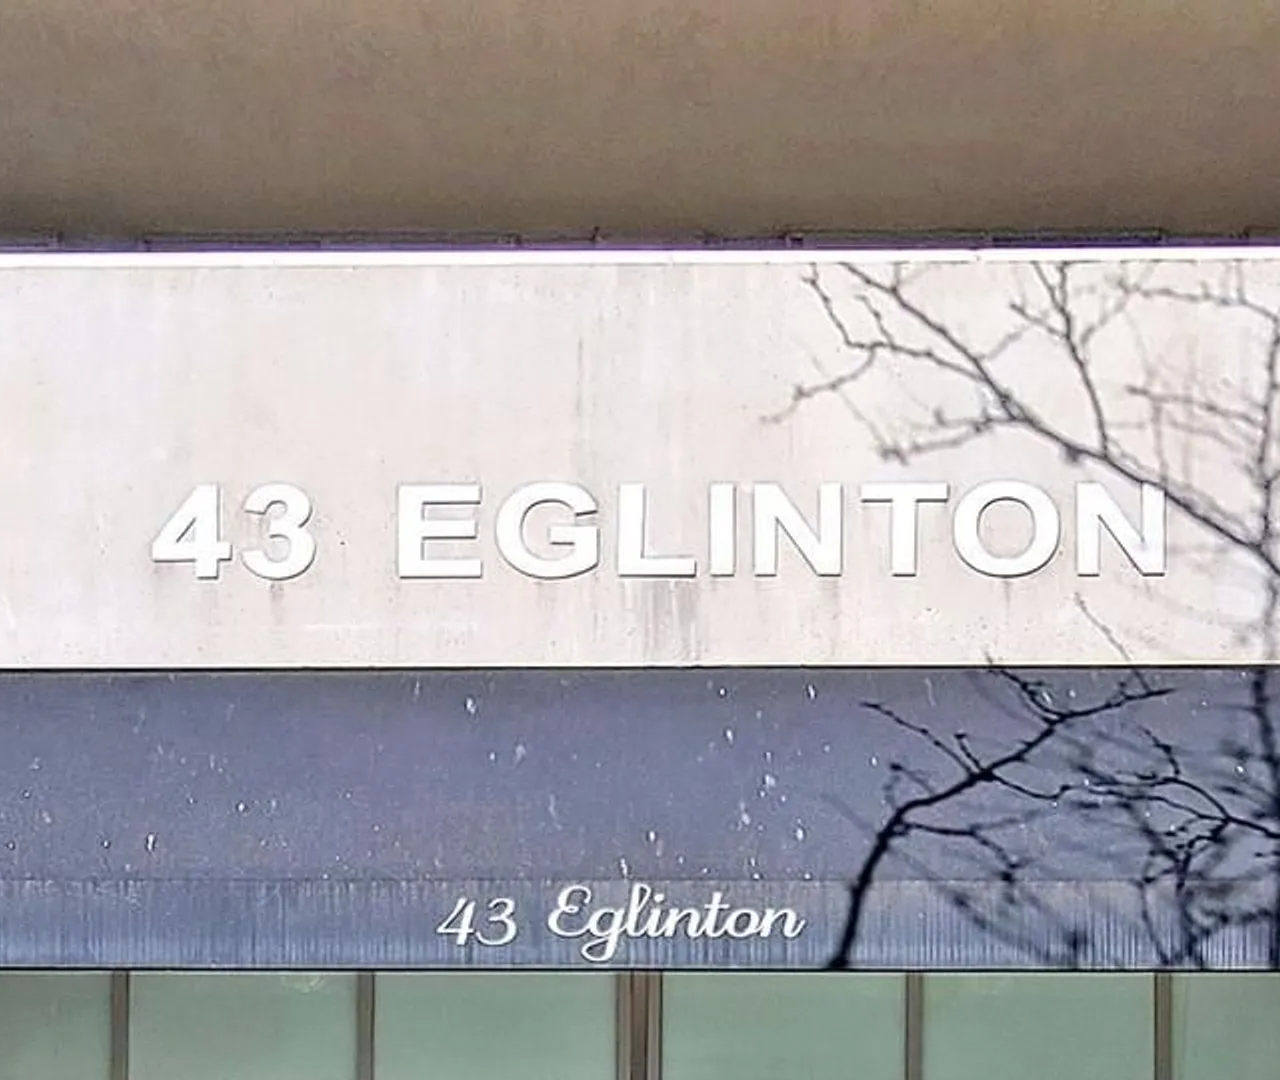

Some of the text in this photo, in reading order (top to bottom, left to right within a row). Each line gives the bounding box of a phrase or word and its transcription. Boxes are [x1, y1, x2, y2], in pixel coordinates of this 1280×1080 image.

[150, 480, 1168, 580] 43 EGLINTON
[436, 882, 807, 962] 43 Eglinton
